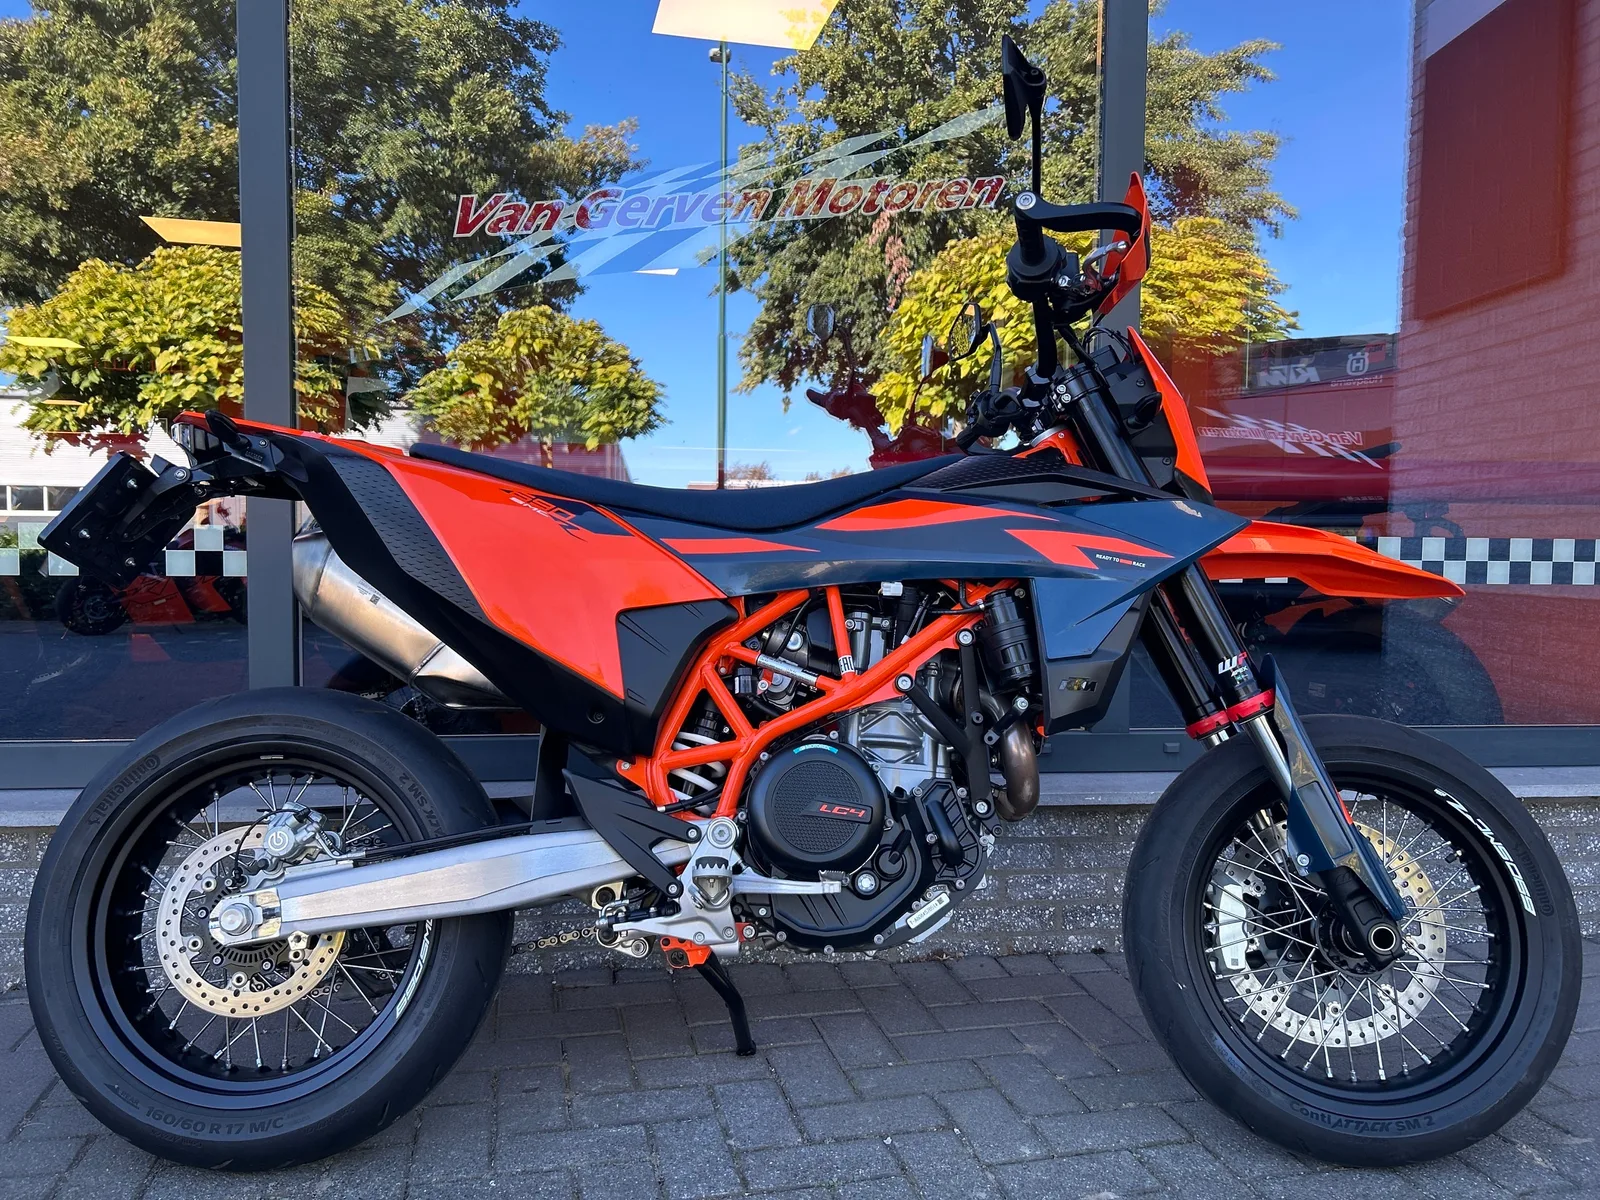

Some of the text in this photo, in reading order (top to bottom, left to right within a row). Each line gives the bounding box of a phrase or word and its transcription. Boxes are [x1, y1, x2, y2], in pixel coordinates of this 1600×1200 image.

[454, 174, 1006, 238] Van Gerven Motoren
[1095, 553, 1113, 562] READY
[1217, 651, 1248, 675] WP
[819, 803, 867, 818] LC4
[145, 1105, 206, 1134] 160/60
[208, 1121, 222, 1135] R
[225, 1122, 245, 1136] 17
[248, 1116, 285, 1135] M/C
[1396, 1118, 1421, 1132] SM
[1424, 1115, 1437, 1127] 2
